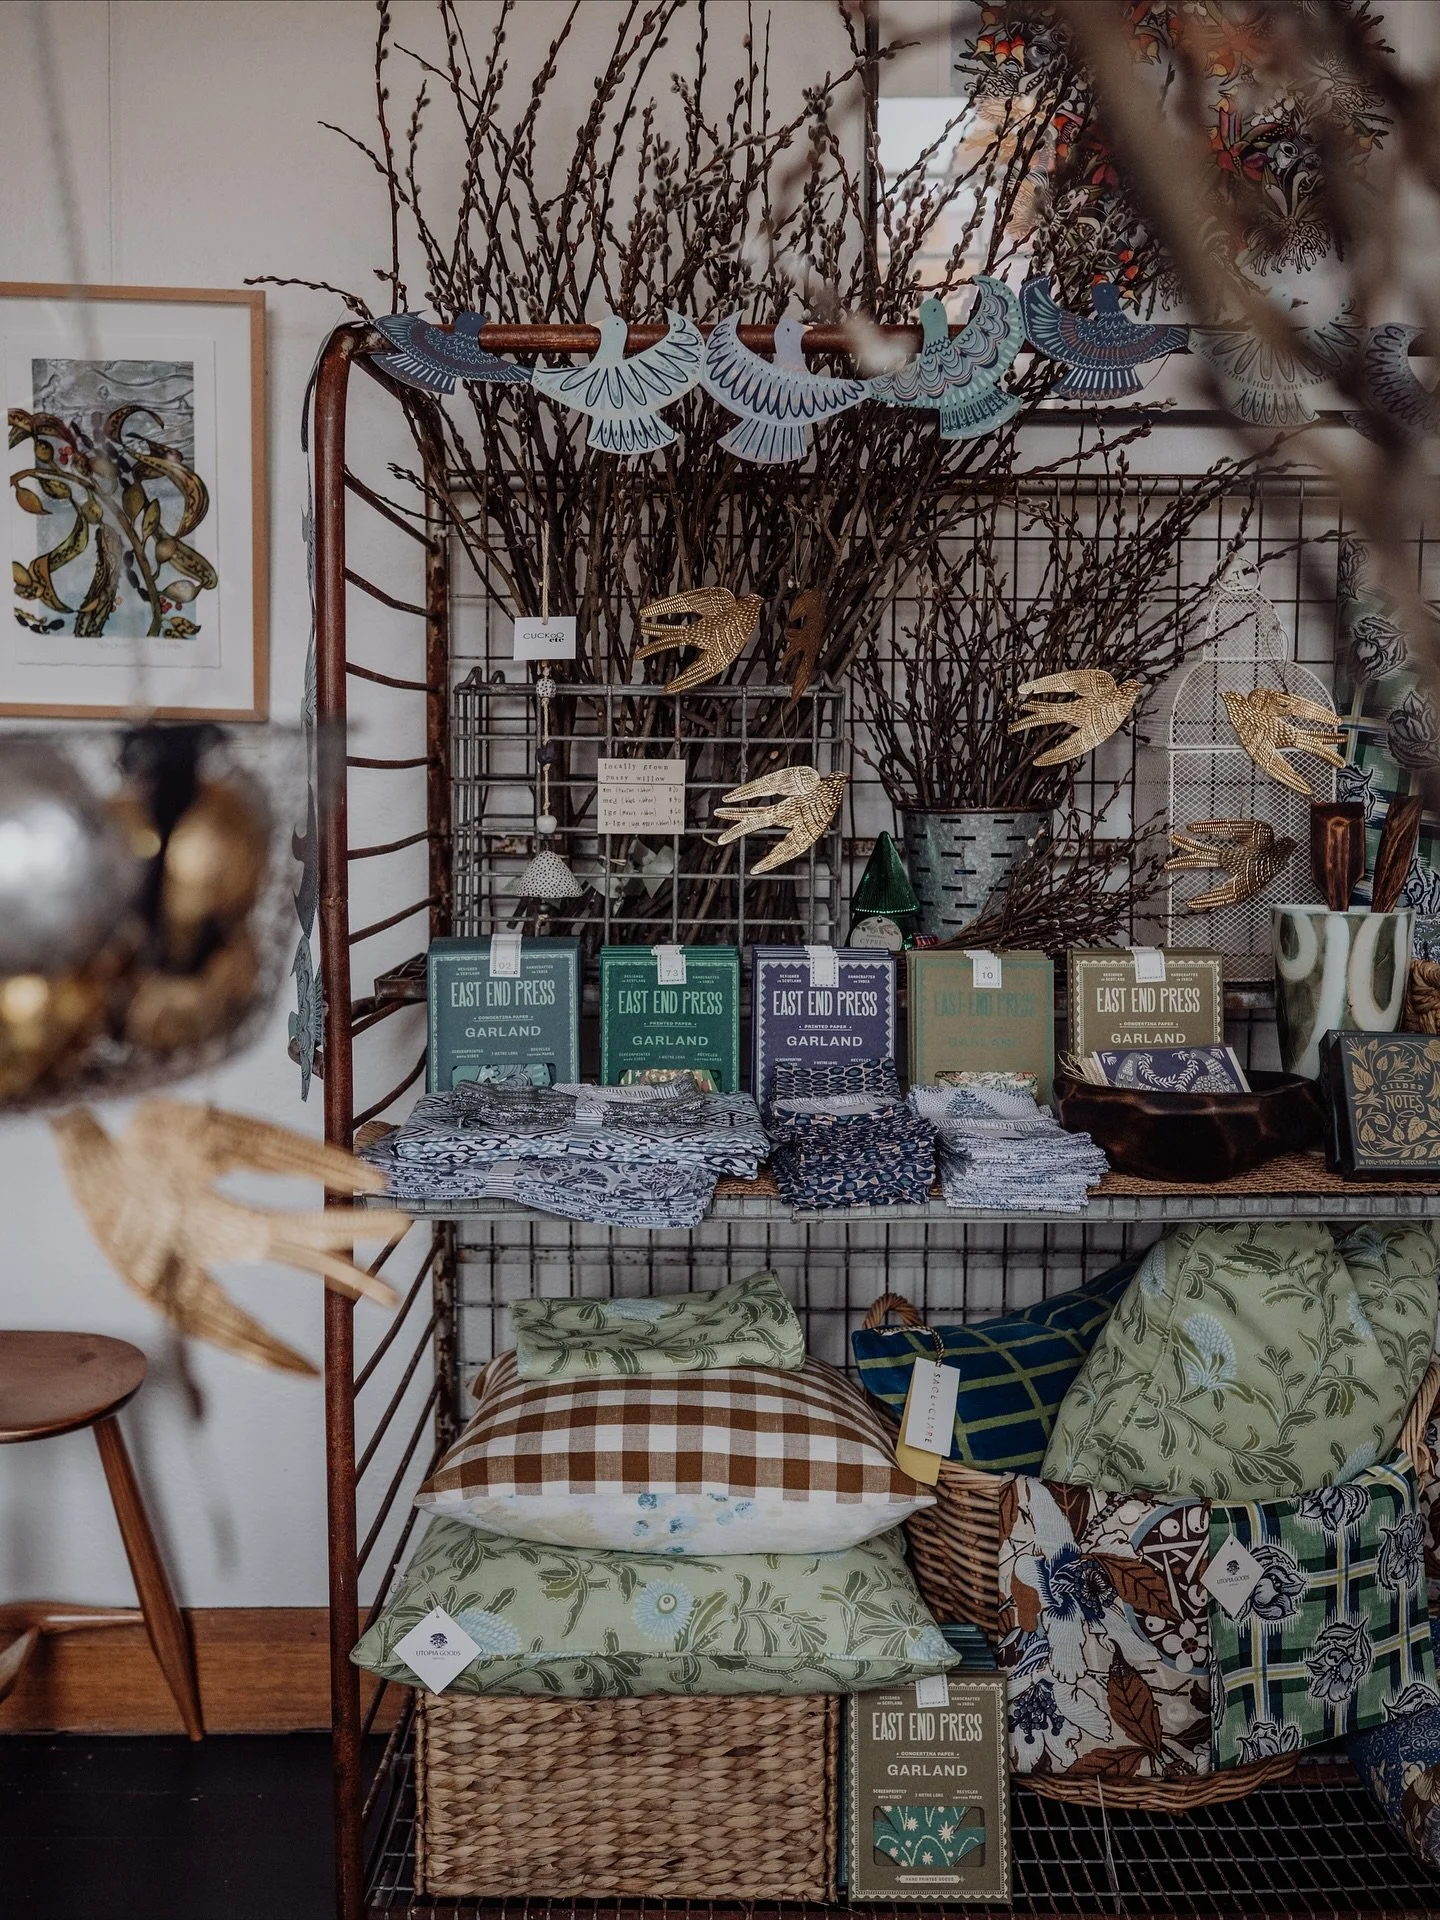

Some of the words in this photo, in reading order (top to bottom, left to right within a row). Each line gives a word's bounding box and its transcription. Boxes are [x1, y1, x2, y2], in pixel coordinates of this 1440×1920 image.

[982, 971, 994, 979] 10
[451, 981, 482, 1007] EAST
[486, 981, 511, 1007] END
[515, 979, 556, 1006] PRESS
[1096, 987, 1127, 1013] EAST
[1131, 987, 1156, 1013] END
[1160, 987, 1201, 1013] PRESS
[618, 990, 649, 1014] EAST
[653, 990, 678, 1014] END
[682, 991, 723, 1015] PRESS
[773, 991, 804, 1016] EAST
[808, 991, 833, 1016] END
[837, 991, 878, 1017] PRESS
[968, 991, 992, 1016] END
[465, 1025, 541, 1038] GARLAND
[1111, 1033, 1186, 1044] GARLAND
[632, 1035, 709, 1046] GARLAND
[786, 1036, 863, 1047] GARLAND
[1381, 1083, 1424, 1091] GILDED
[1383, 1094, 1425, 1114] NOTES
[872, 1712, 904, 1741] EAST
[909, 1713, 936, 1741] END
[940, 1713, 983, 1742] PRESS
[887, 1764, 968, 1776] GARLAND
